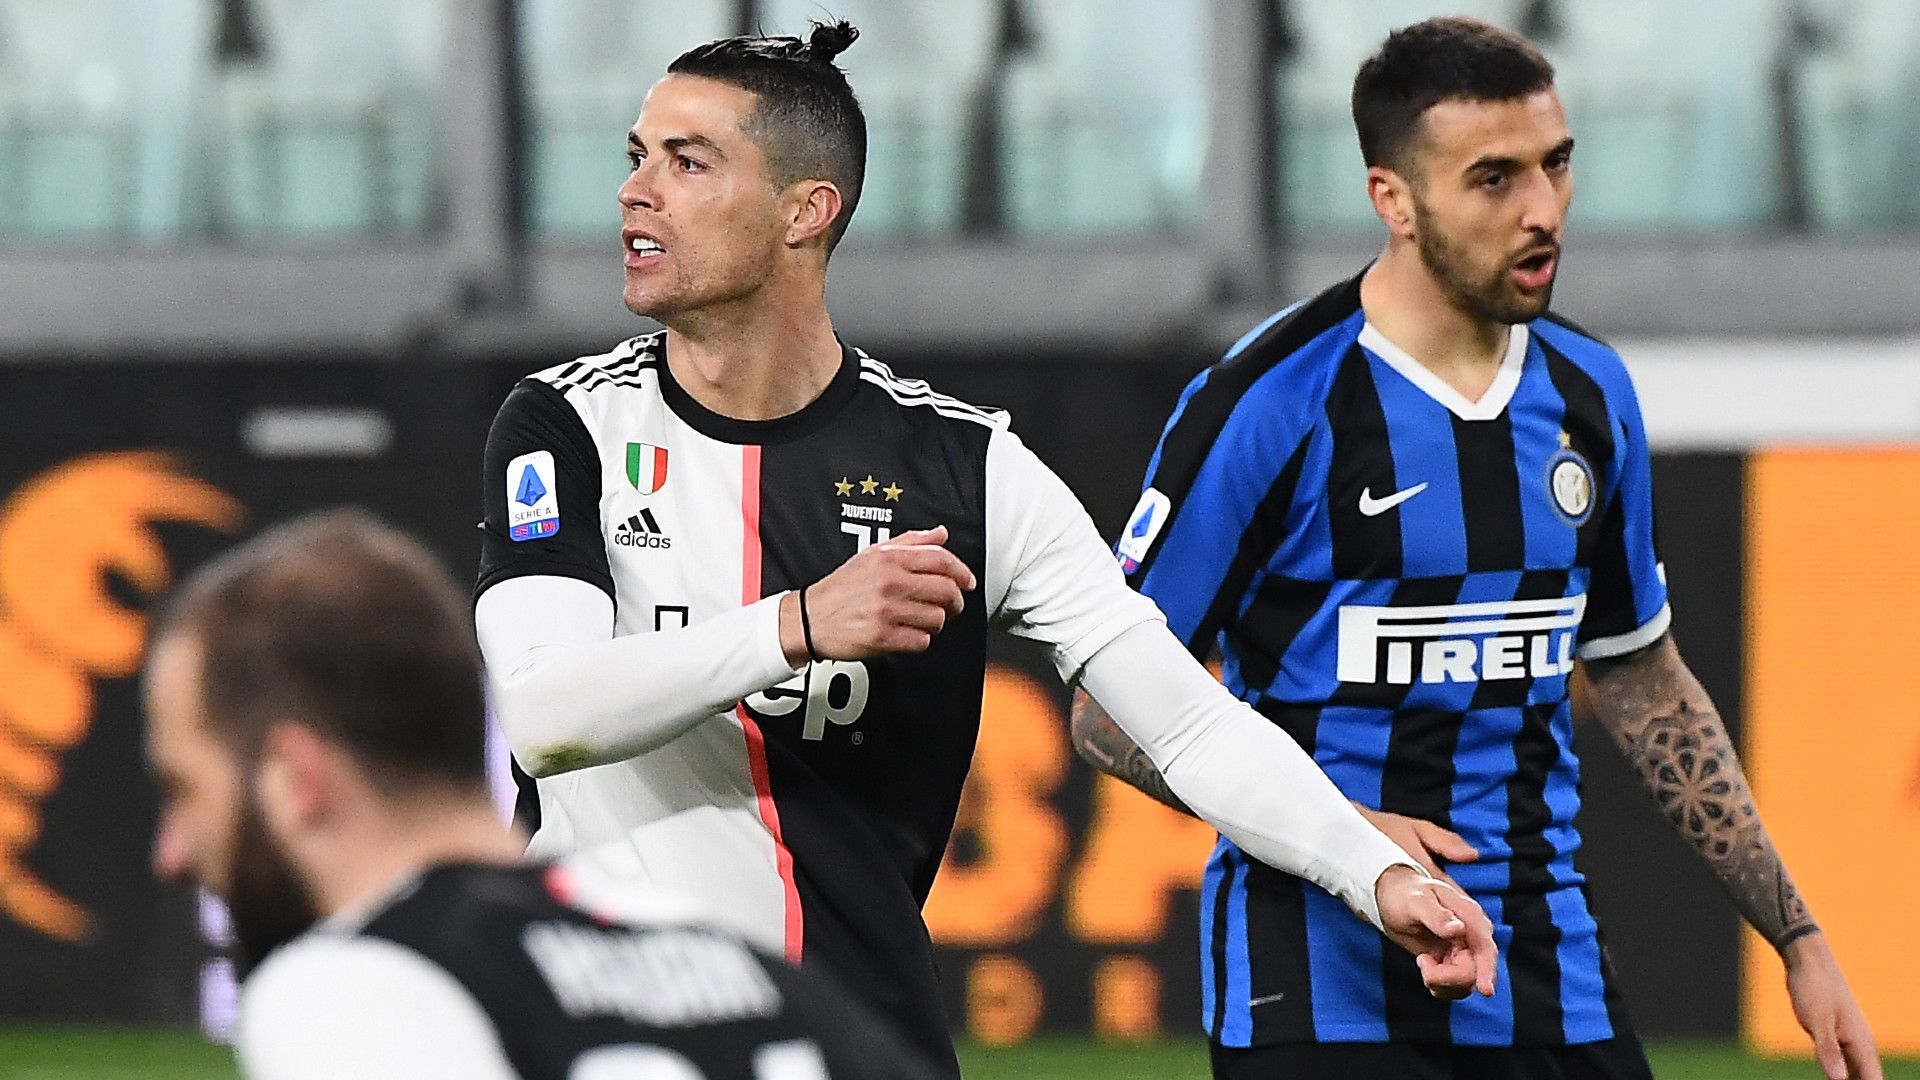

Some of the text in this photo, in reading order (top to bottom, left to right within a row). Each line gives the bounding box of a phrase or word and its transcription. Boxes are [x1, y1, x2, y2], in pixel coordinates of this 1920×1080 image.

[514, 509, 542, 522] SERIE
[841, 503, 893, 522] JUVENTUS
[614, 532, 672, 549] adidas
